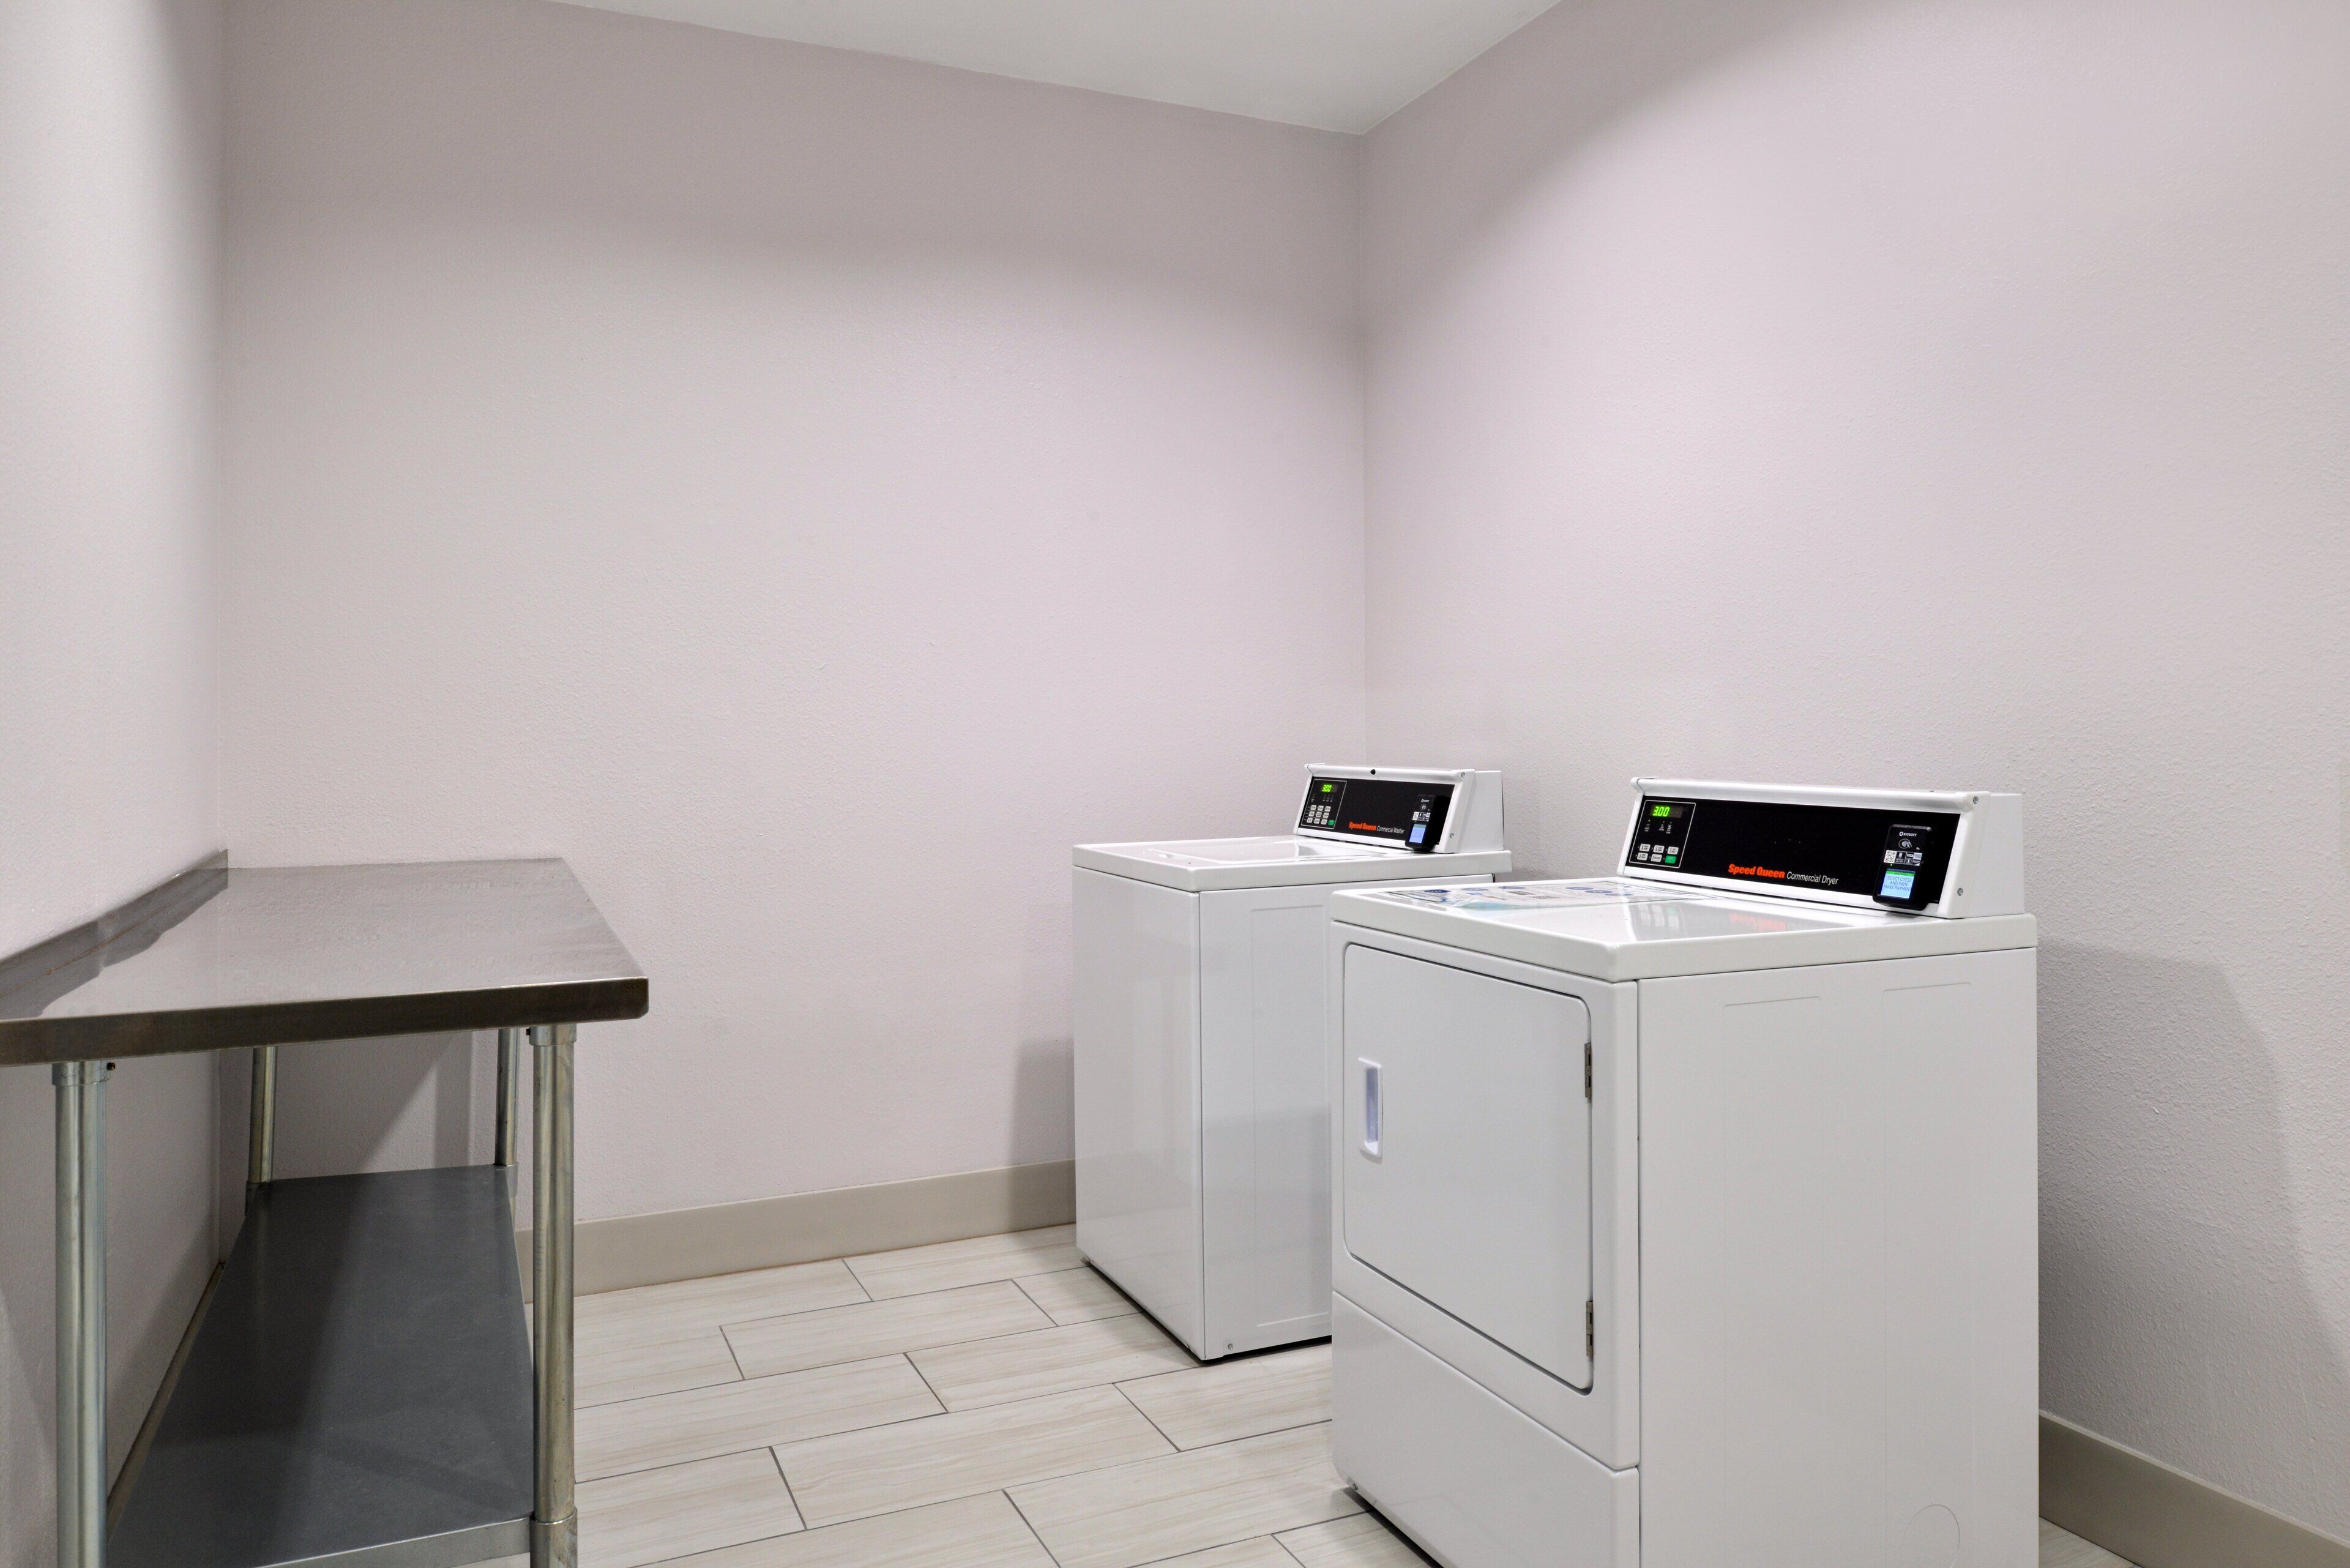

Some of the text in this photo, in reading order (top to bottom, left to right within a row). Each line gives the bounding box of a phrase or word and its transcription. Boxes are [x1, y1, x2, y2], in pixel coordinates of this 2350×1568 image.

[1652, 806, 1670, 817] 3.00
[1728, 864, 1838, 886] Speed Queen Commercial Dryer
